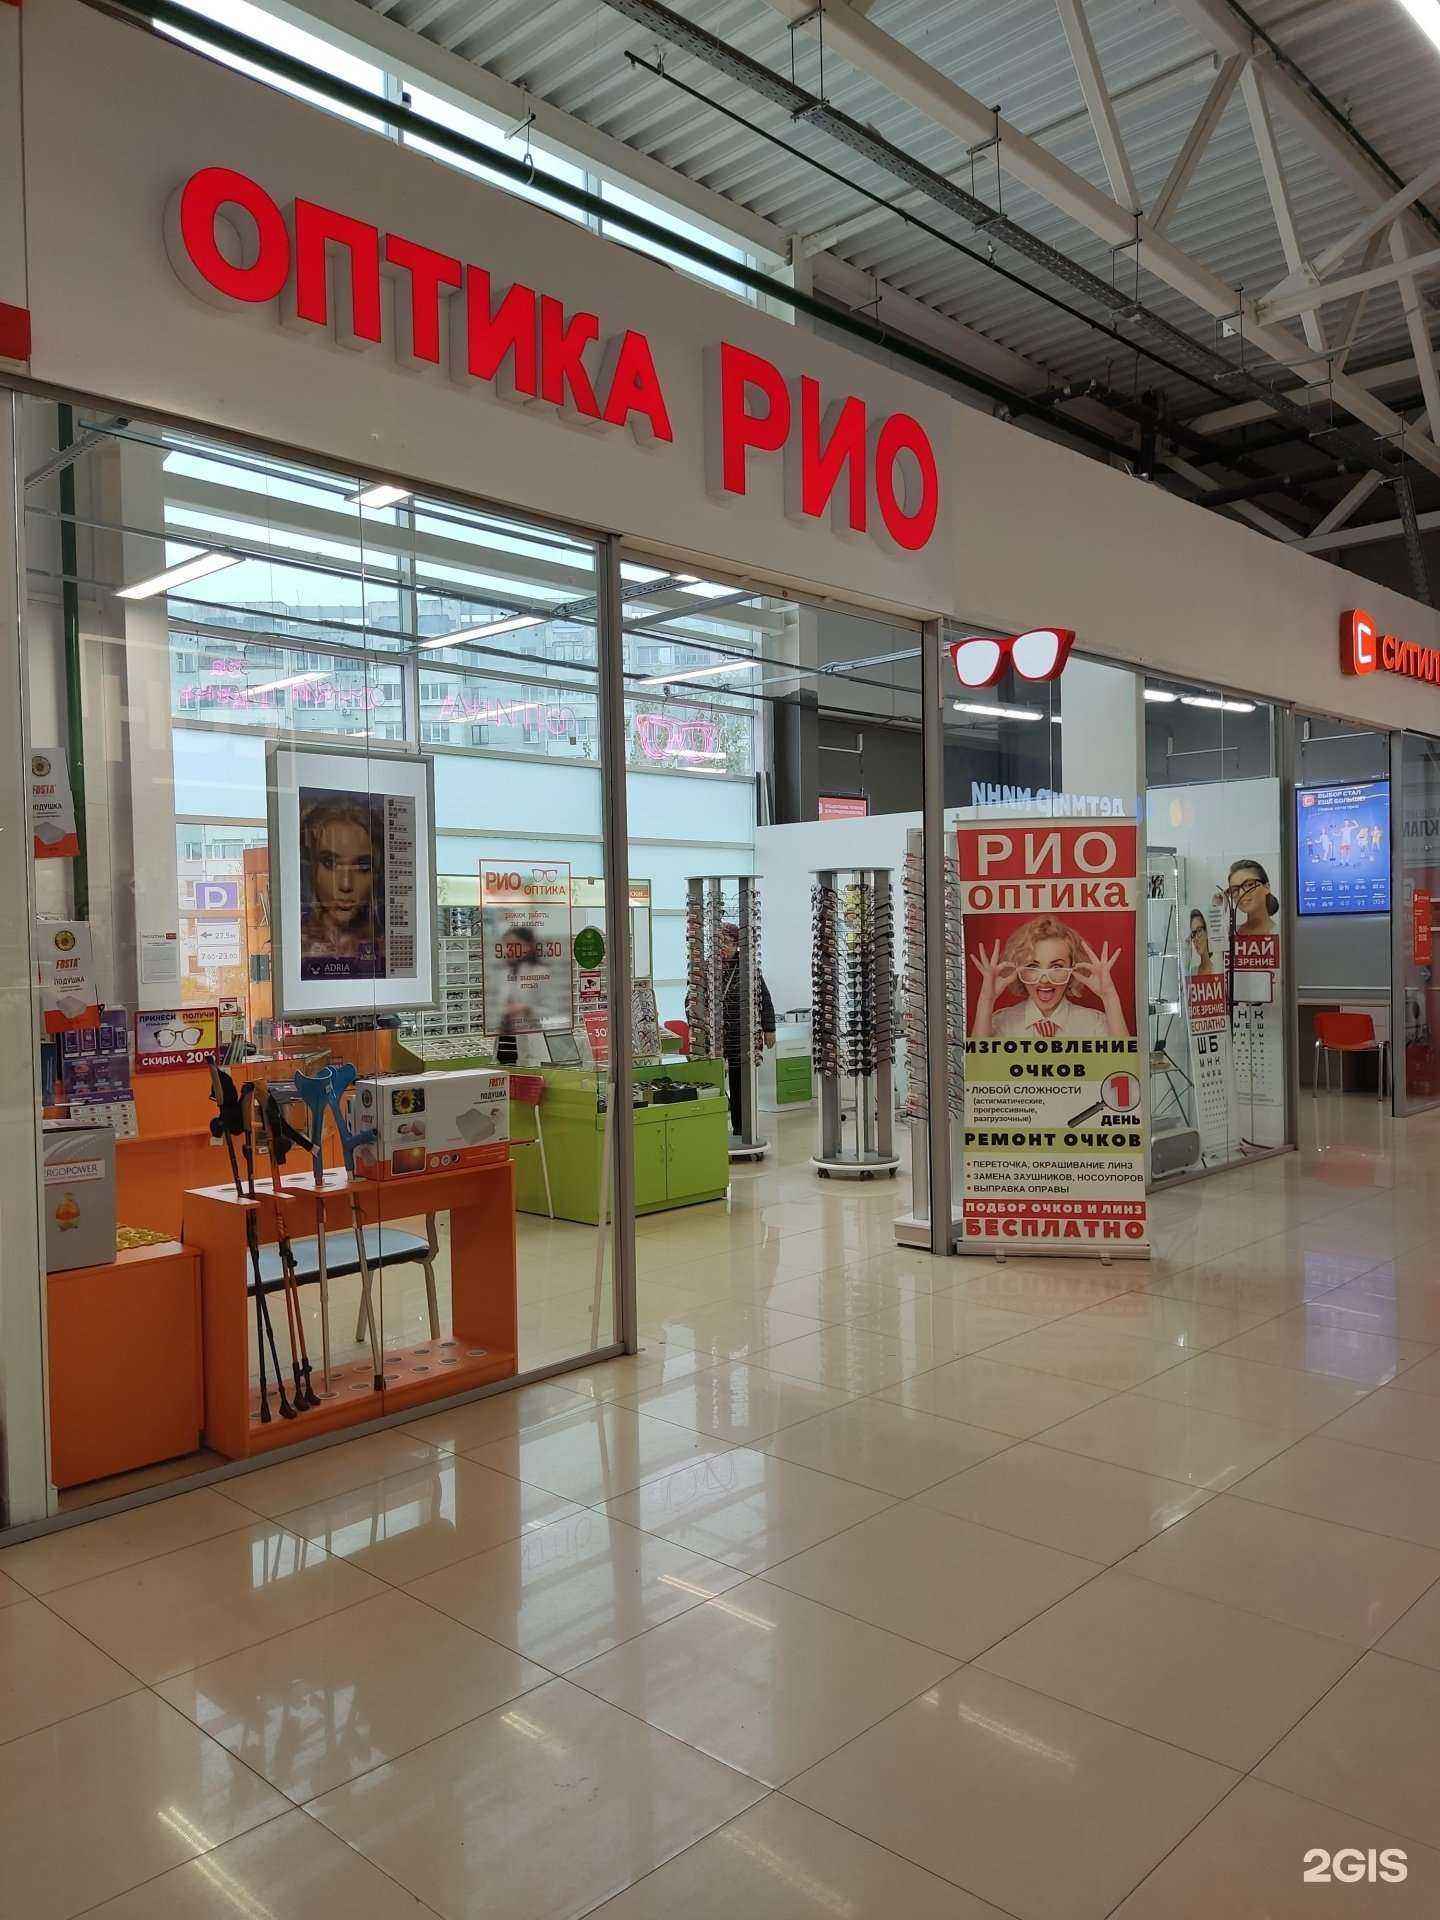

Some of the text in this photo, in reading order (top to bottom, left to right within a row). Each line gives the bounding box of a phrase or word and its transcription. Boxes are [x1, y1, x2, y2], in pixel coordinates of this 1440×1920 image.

[181, 166, 938, 552] ОПТИКА РИО
[977, 831, 1117, 876] РИО
[485, 872, 522, 891] РИО
[524, 885, 566, 896] ОПТИКА
[968, 882, 1129, 910] оптика
[495, 942, 562, 960] 9.30-9.30
[1233, 936, 1275, 956] НАЙ
[324, 963, 350, 972] ADRIA
[1238, 957, 1275, 967] ЗРЕНИЕ
[182, 1011, 215, 1020] ПОЛУЧИ
[1191, 1018, 1226, 1032] ЕСПЛАТНО
[965, 1040, 1138, 1053] ИЗГОТОВЛЕНИЕ
[142, 1055, 184, 1065] СКИДКА
[1010, 1063, 1086, 1077] ОЧКОВ
[972, 1085, 1081, 1095] ЛЮБОЙ СЛОЖНОСТИ
[1111, 1076, 1129, 1107] 1
[973, 1097, 1045, 1106] (астигматические,
[973, 1106, 1037, 1115] прогрессивные,
[973, 1115, 1032, 1124] разгрузочные)
[1101, 1114, 1141, 1127] ДЕНЬ
[964, 1133, 1142, 1147] РЕМОНТ ОЧКОВ
[973, 1160, 1030, 1169] ПЕРЕТОЧКА,
[1032, 1161, 1105, 1169] ОКРАШИВАНИЕ
[973, 1173, 1144, 1182] ЗАМЕНА ЗАУШНИКОВ, НОСОУПОРОВ
[973, 1185, 1070, 1194] ВЫПРАВКА ОПРАВЫ
[965, 1202, 1143, 1215] ПОДБОР ОЧКОВ И ЛИНЗ
[965, 1219, 1144, 1239] БЕСПЛАТНО
